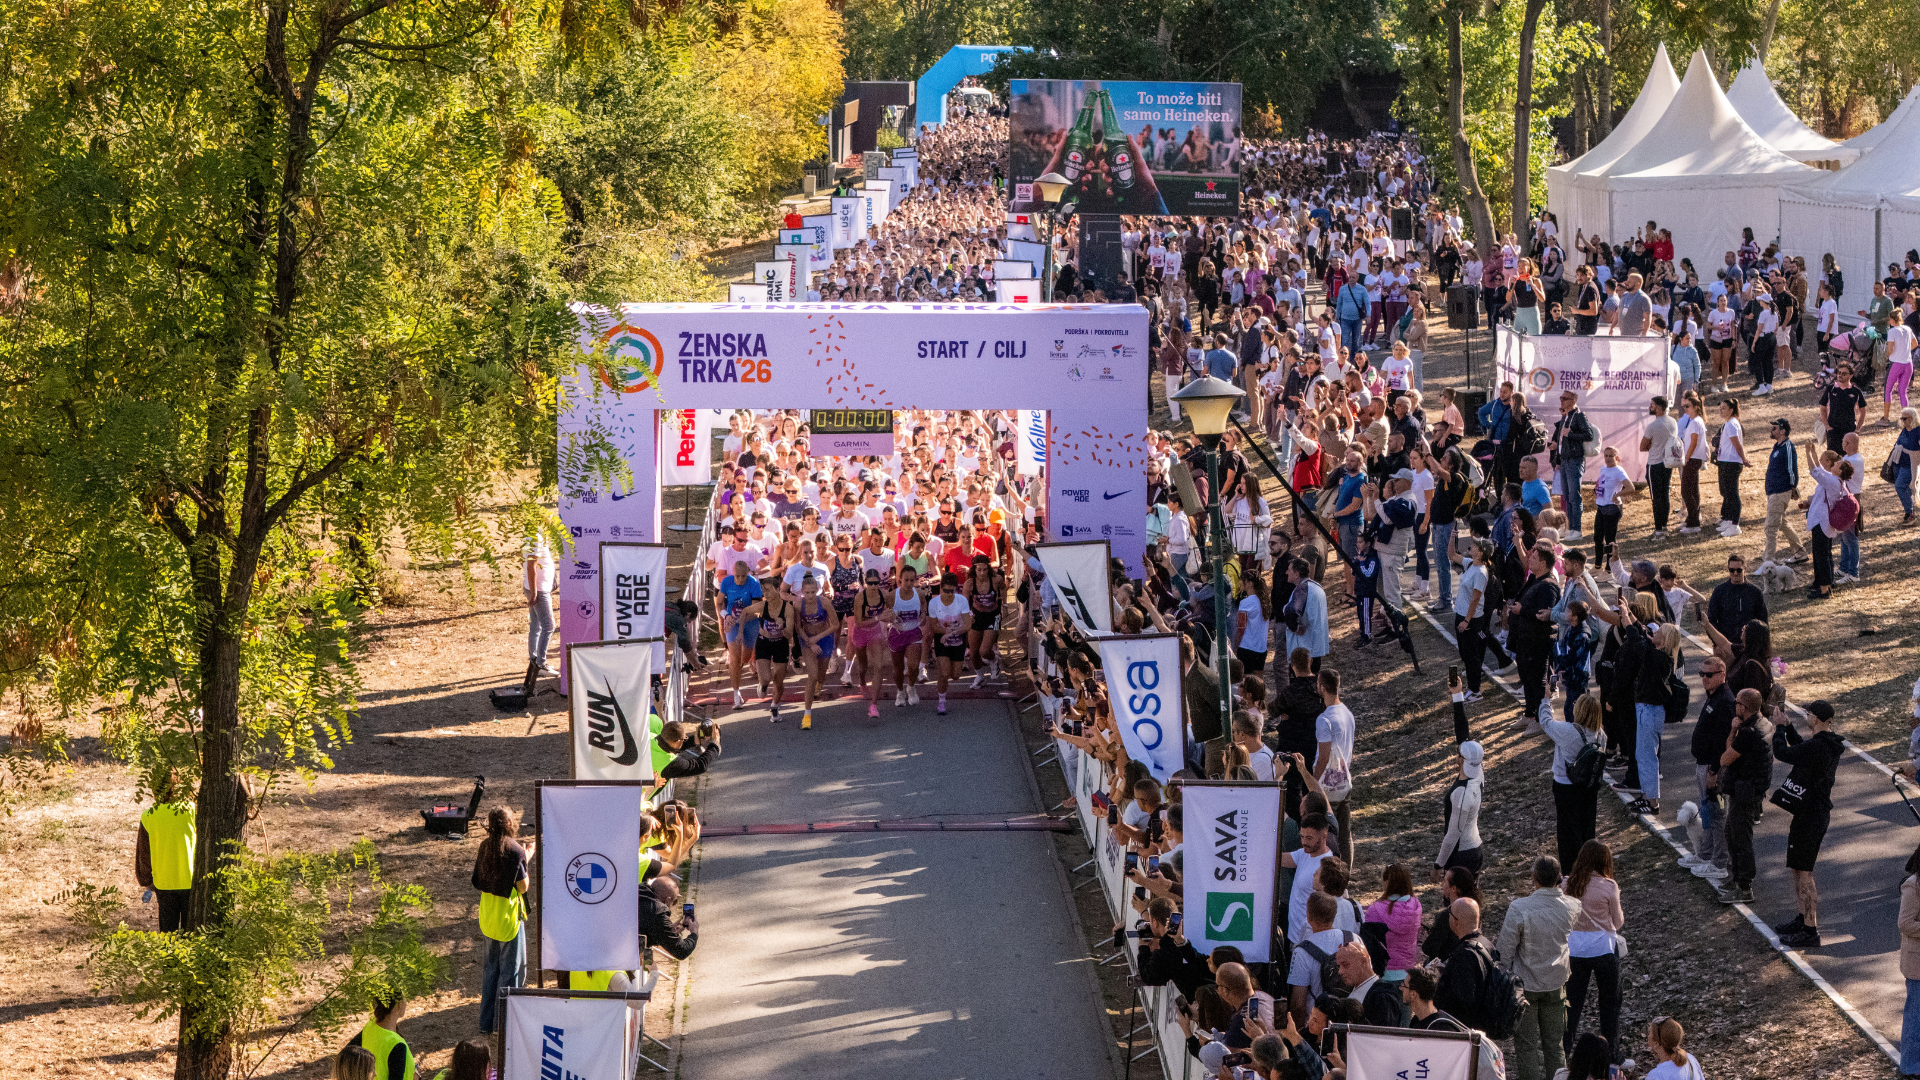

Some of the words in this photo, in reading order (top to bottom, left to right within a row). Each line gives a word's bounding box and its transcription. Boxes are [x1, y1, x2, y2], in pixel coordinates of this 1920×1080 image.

[1137, 92, 1154, 104] To
[1157, 92, 1194, 105] može
[1197, 92, 1222, 106] biti
[1124, 110, 1160, 121] samo
[1164, 108, 1234, 122] Heineken.
[840, 204, 849, 227] UŠĆE
[678, 332, 767, 357] ŽENSKA
[917, 340, 969, 359] START
[977, 341, 986, 359] /
[994, 341, 1027, 359] CILJ
[1604, 381, 1647, 390] MARATON
[1605, 371, 1660, 381] BEOGRADSKI
[816, 411, 886, 427] 0:00:00
[1026, 410, 1046, 462] Wellne
[633, 574, 650, 616] ADE
[587, 690, 616, 753] RUN
[1127, 660, 1164, 771] osa
[1214, 810, 1238, 882] SAVA
[1240, 810, 1249, 882] OSIGURANJE
[568, 859, 582, 897] BMW
